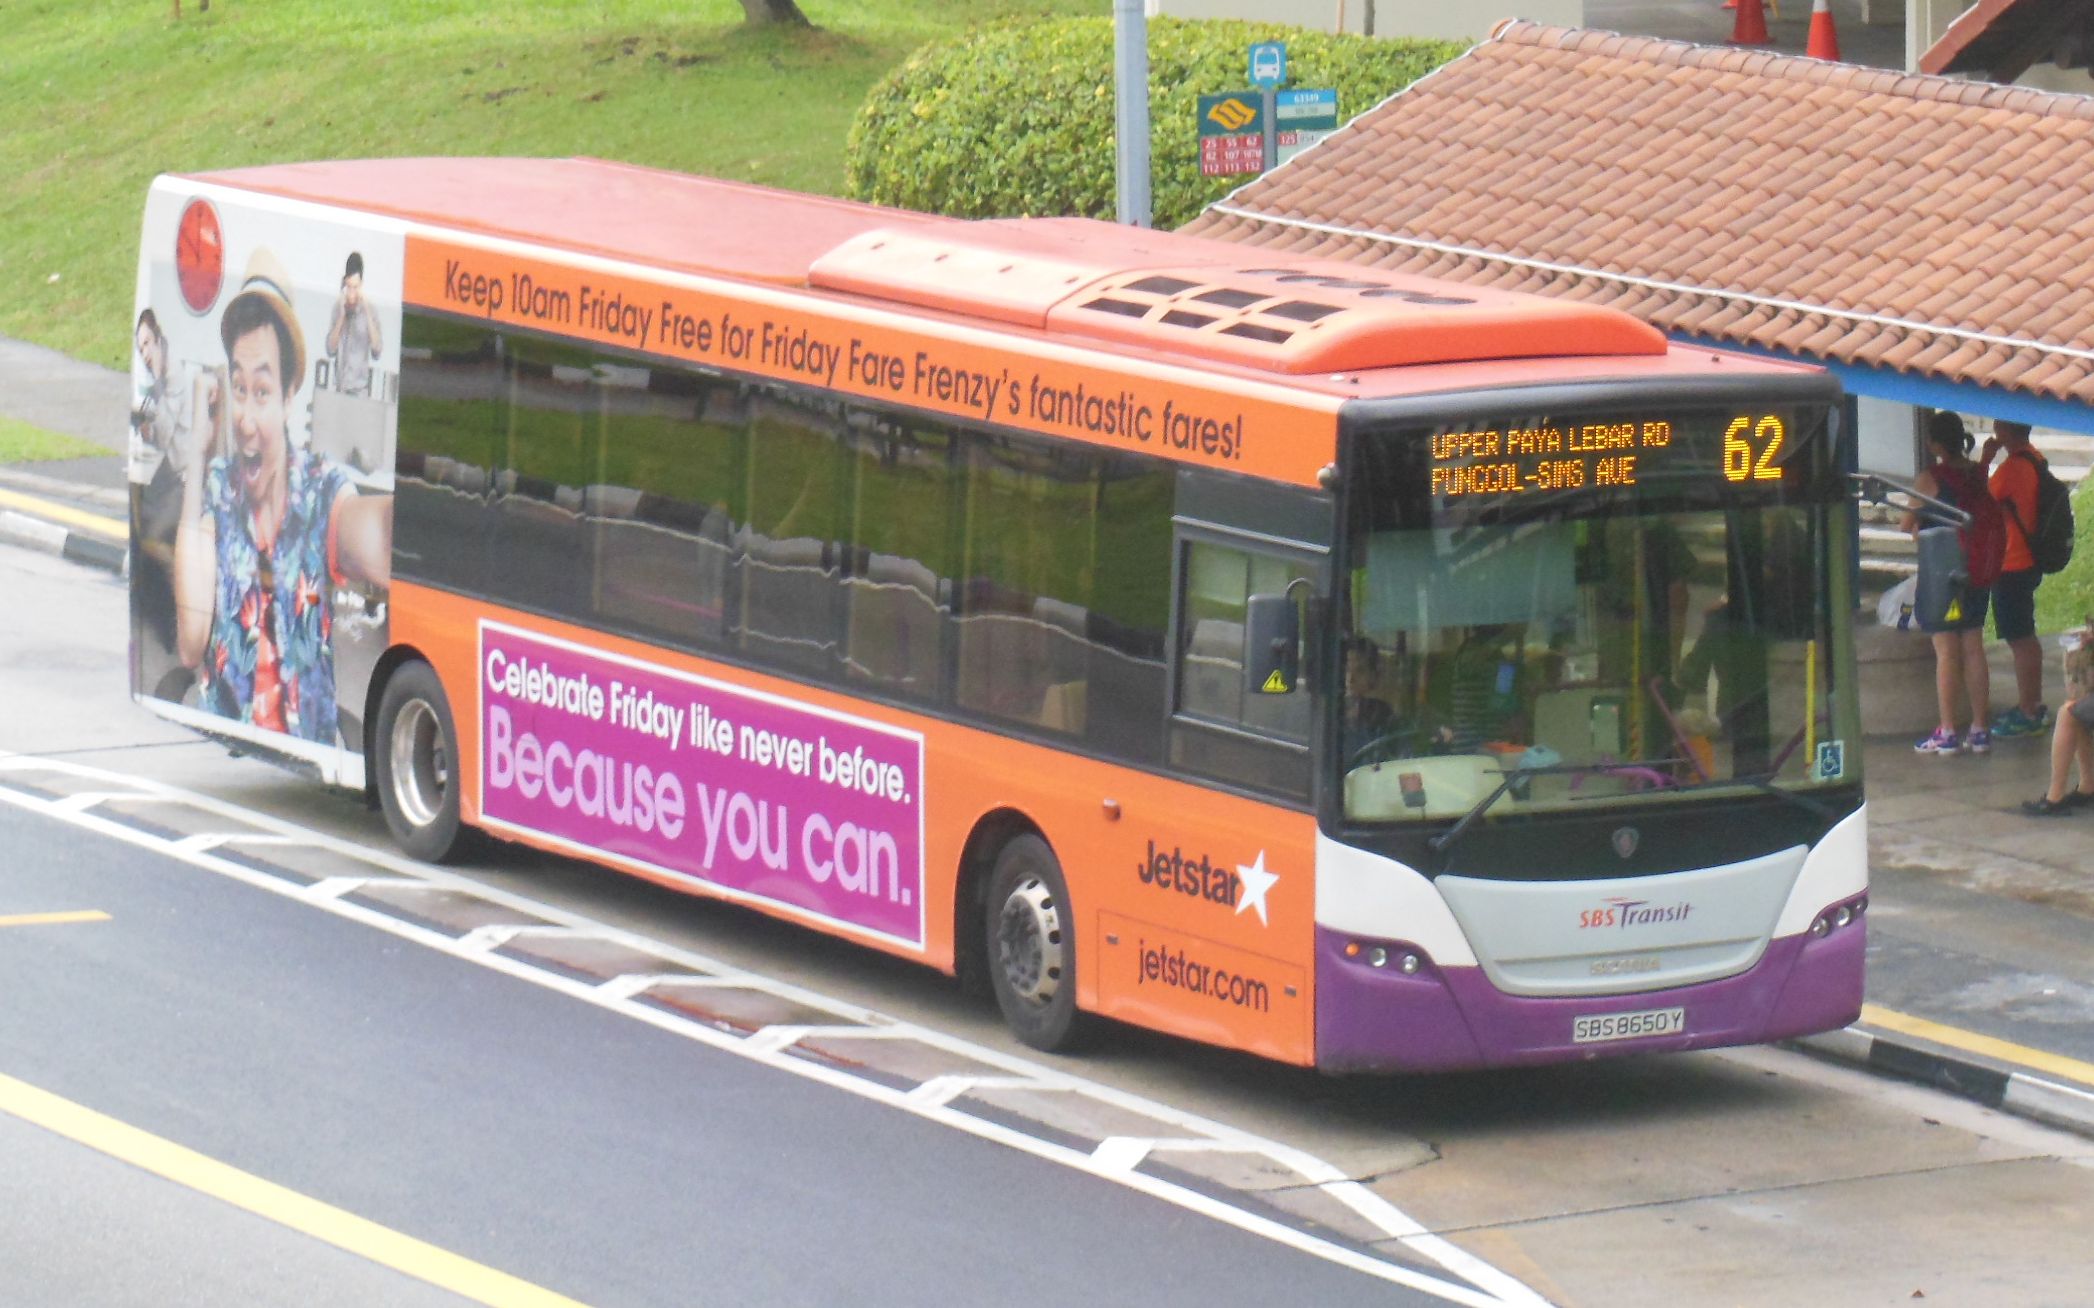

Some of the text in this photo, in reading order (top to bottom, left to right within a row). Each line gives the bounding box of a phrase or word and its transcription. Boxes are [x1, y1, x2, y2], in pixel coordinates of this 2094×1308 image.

[1203, 164, 1219, 174] 112
[1224, 150, 1240, 160] 107
[445, 259, 1243, 460] Keep 10am Friday Free for Friday Fare Frenzy's fantastic fares!
[1431, 421, 1672, 461] UPPER PAYA LEBAR RD
[1595, 455, 1637, 487] AVE
[1722, 415, 1784, 482] 62
[486, 648, 911, 805] Celebrate Friday like never before.
[488, 703, 912, 906] Because you can.
[1138, 839, 1240, 907] Jetstar
[1138, 938, 1269, 1013] jetstar.com
